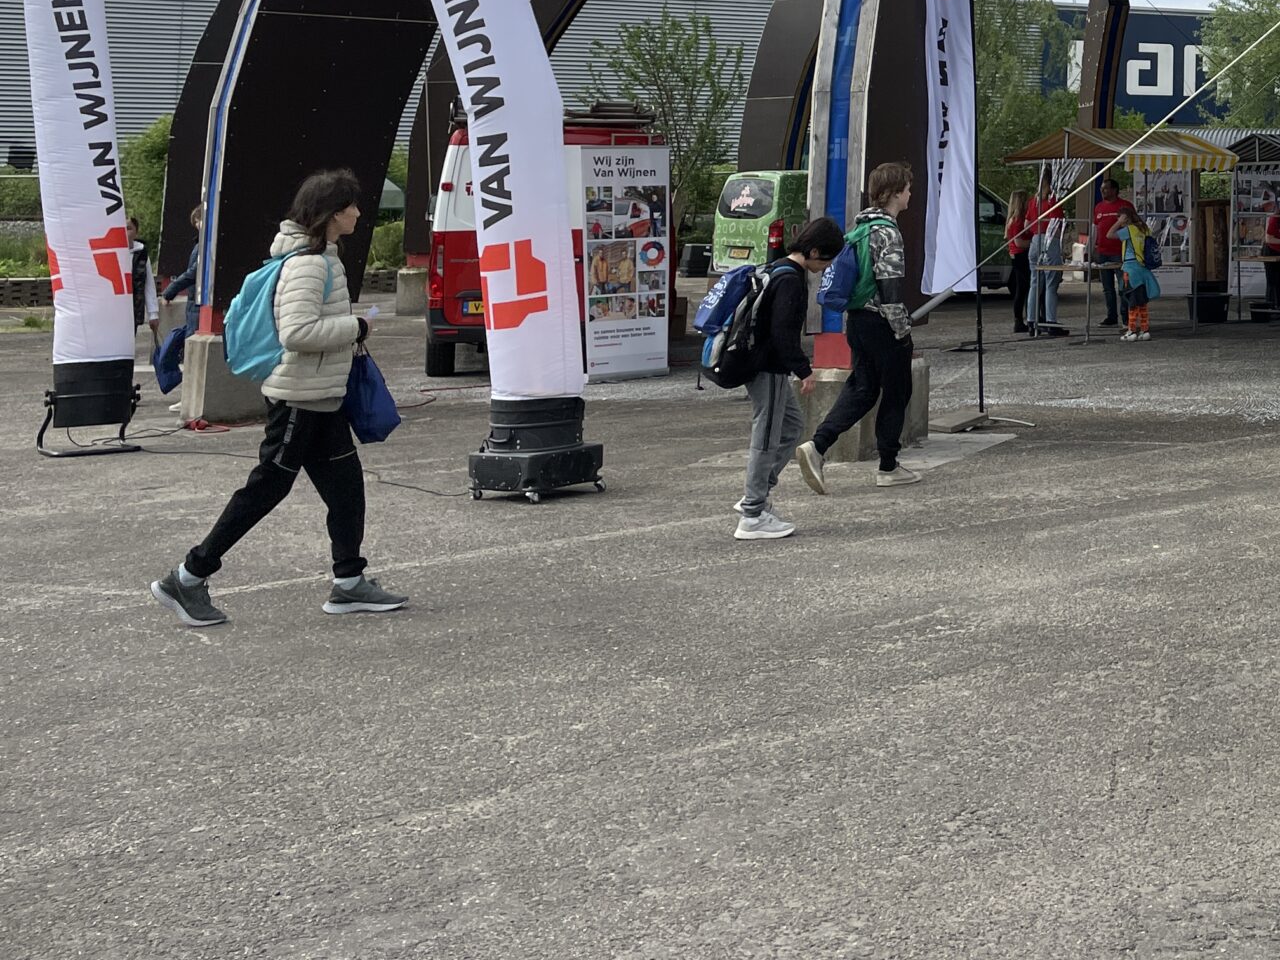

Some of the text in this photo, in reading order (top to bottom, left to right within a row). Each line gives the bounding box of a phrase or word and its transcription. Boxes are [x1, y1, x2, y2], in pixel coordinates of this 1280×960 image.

[88, 142, 125, 216] VAN
[477, 132, 513, 230] VAN
[593, 156, 635, 167] Wij zijn
[593, 168, 656, 179] Van Wijnen
